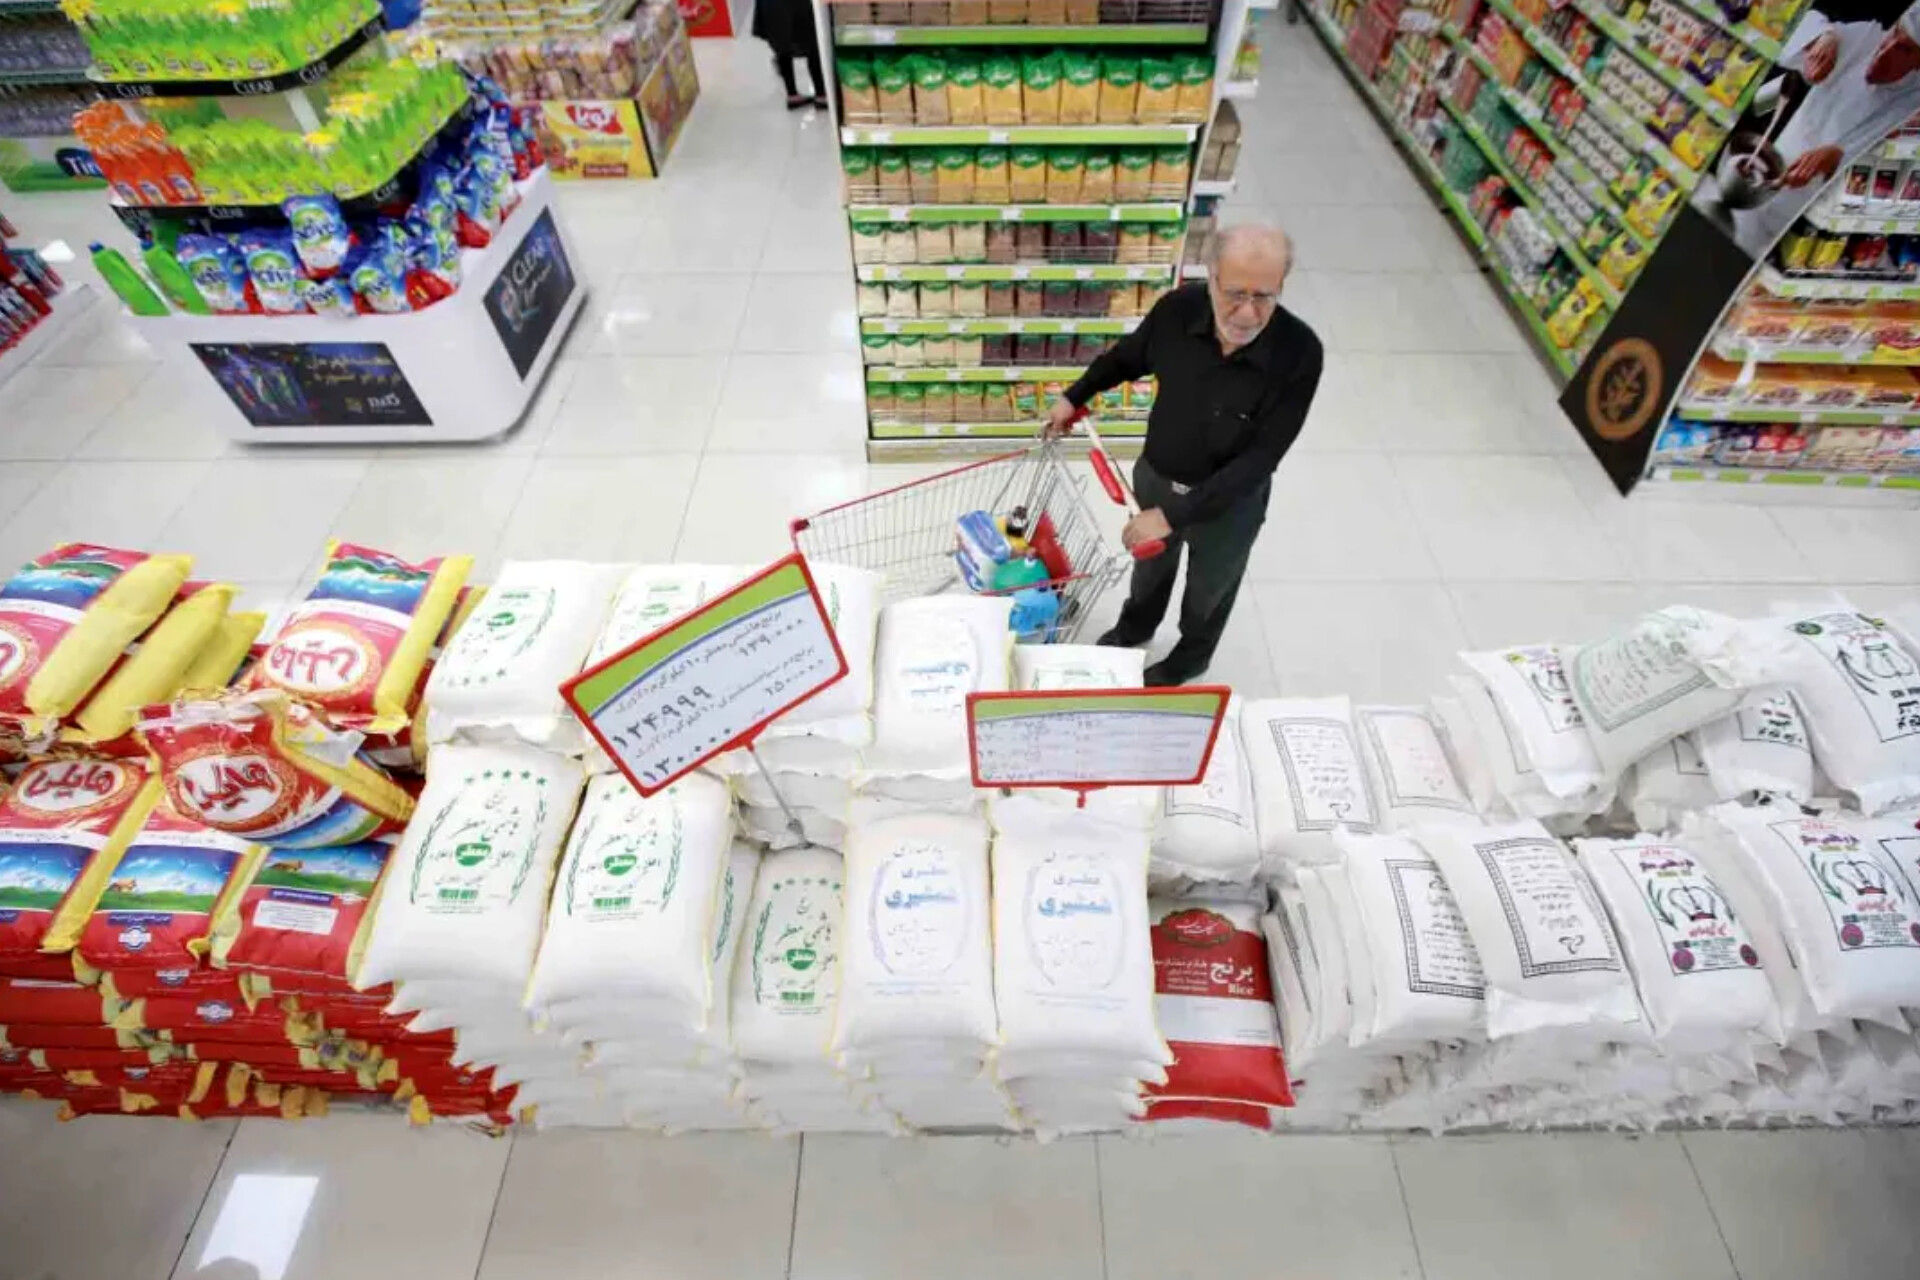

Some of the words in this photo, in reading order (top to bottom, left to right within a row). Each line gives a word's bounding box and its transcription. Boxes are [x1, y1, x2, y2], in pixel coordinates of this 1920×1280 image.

[233, 80, 276, 96] CLEAR
[1210, 956, 1253, 984] برنج
[1227, 982, 1254, 995] Rice
